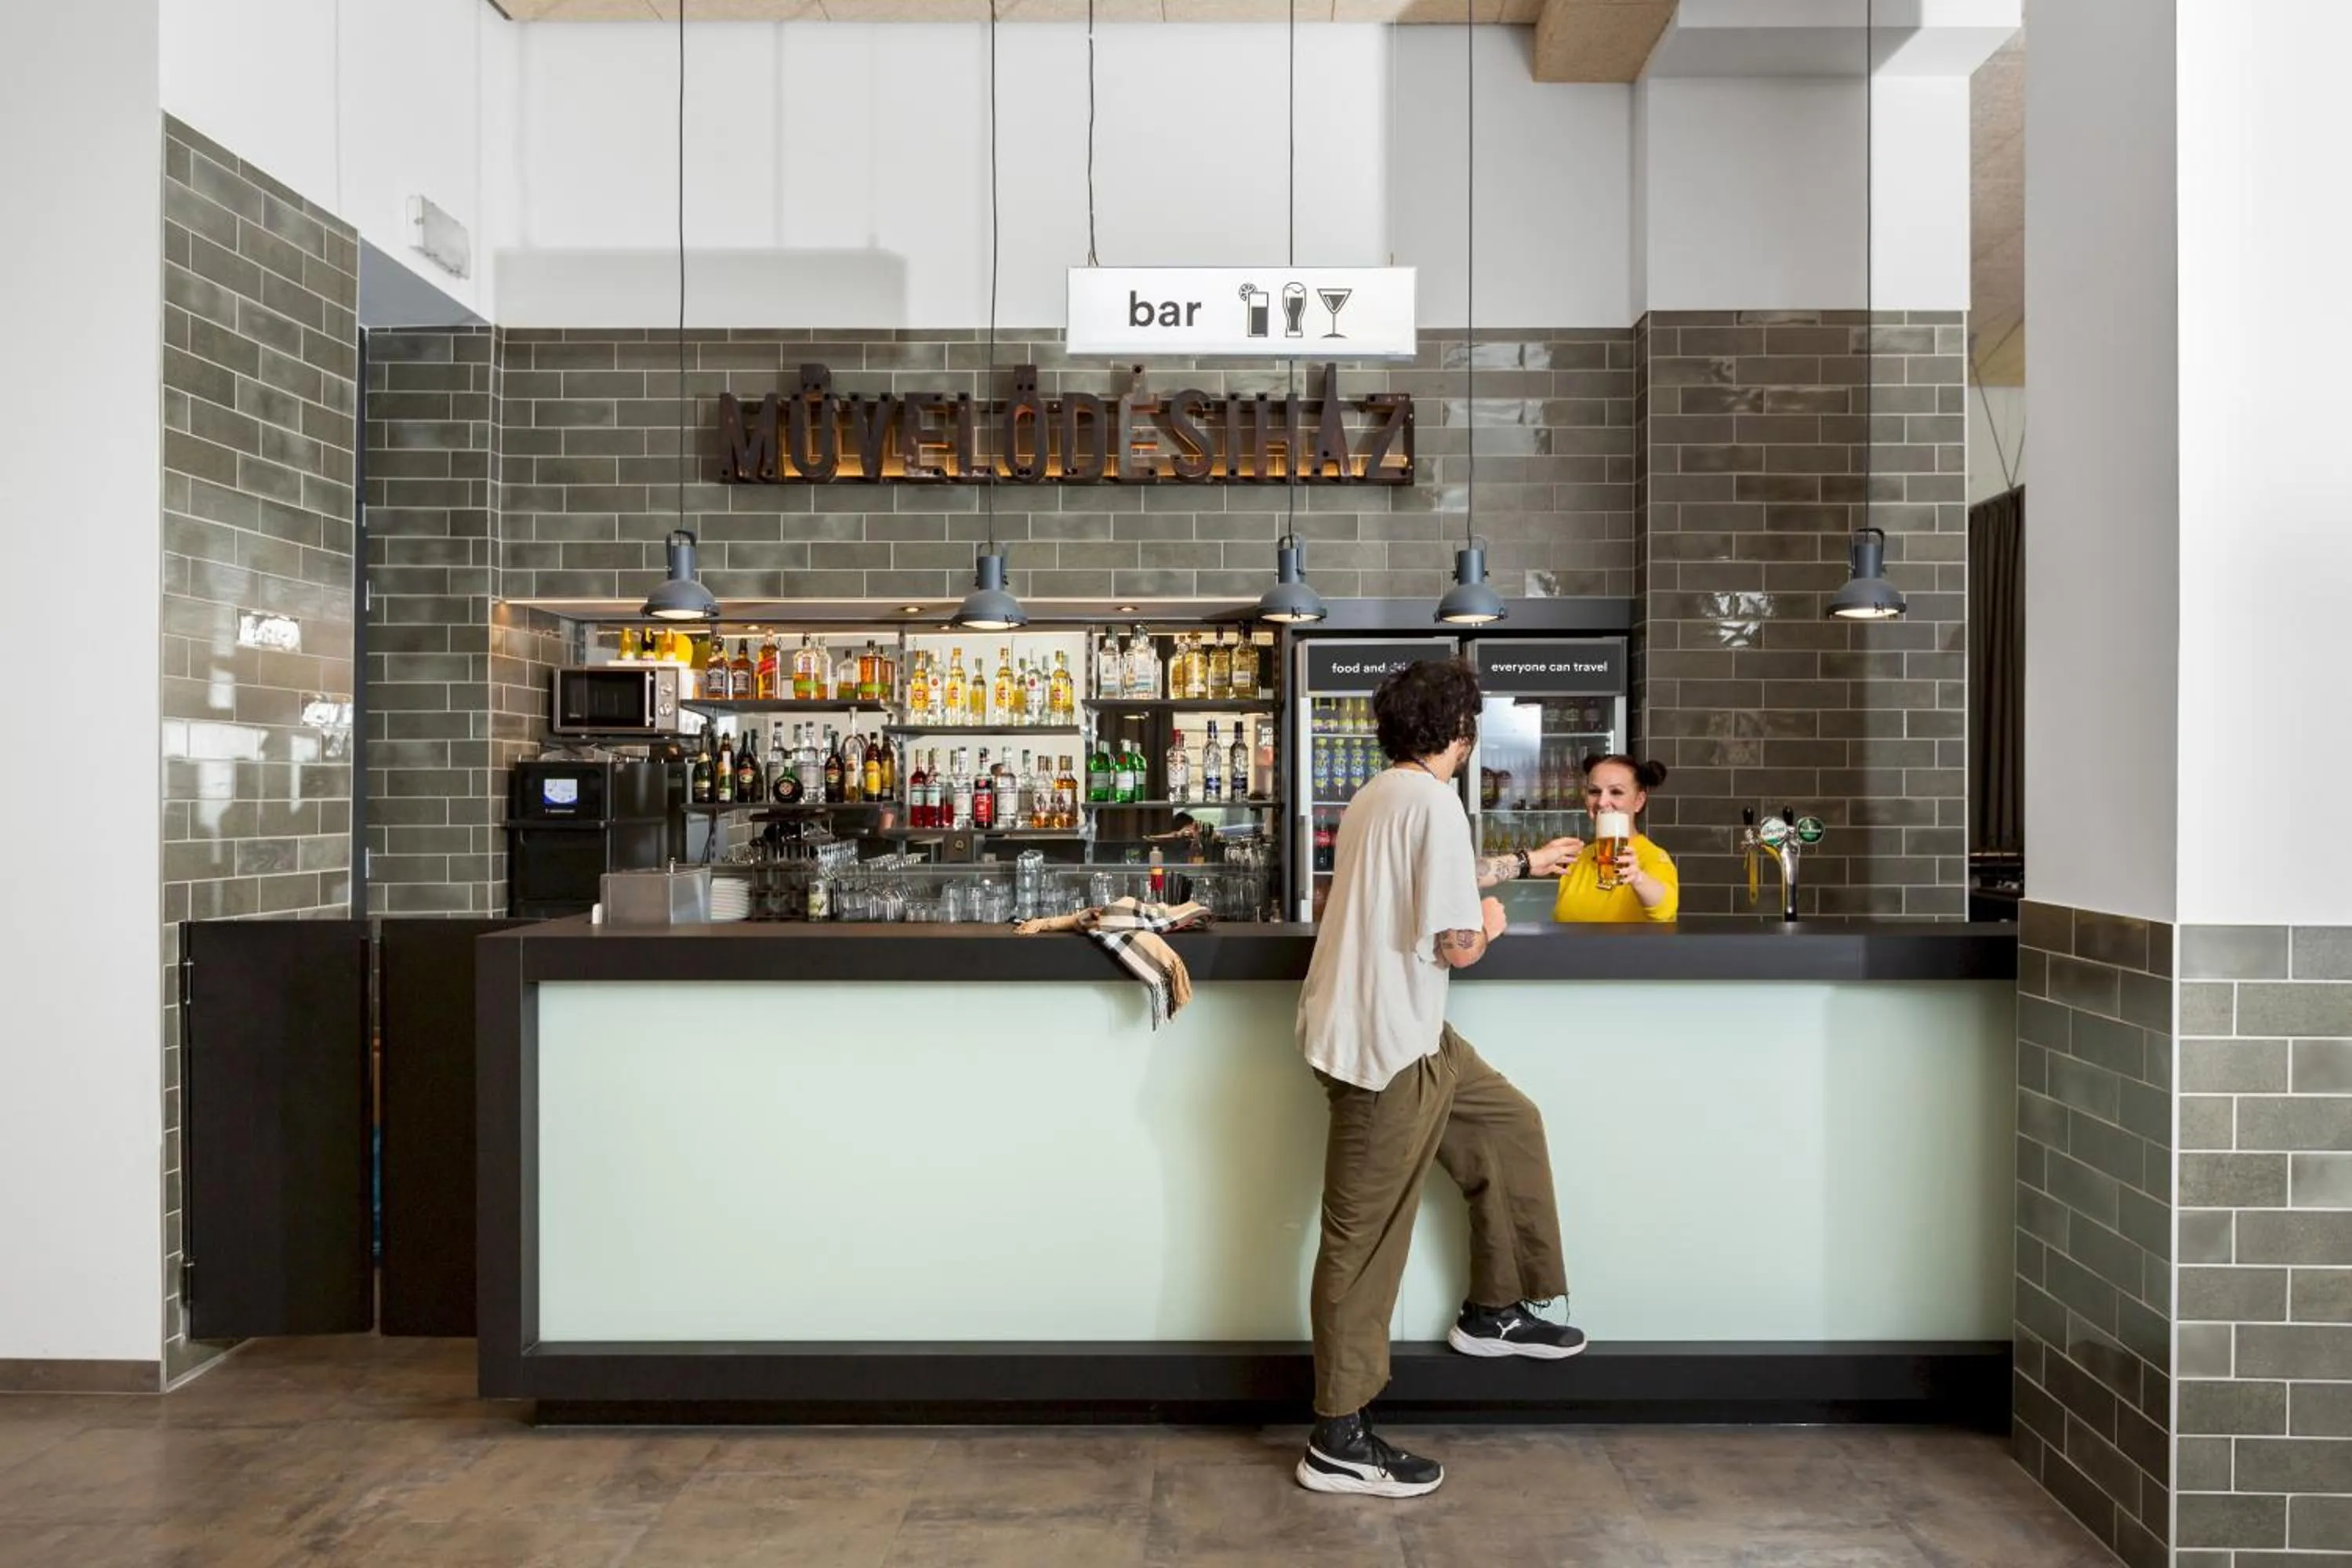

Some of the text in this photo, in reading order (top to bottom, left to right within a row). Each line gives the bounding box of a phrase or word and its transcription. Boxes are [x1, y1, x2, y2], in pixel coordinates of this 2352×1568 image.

[1129, 290, 1202, 327] bar
[1332, 662, 1360, 673] food
[1363, 662, 1385, 673] and
[1490, 660, 1608, 674] everyone can travel
